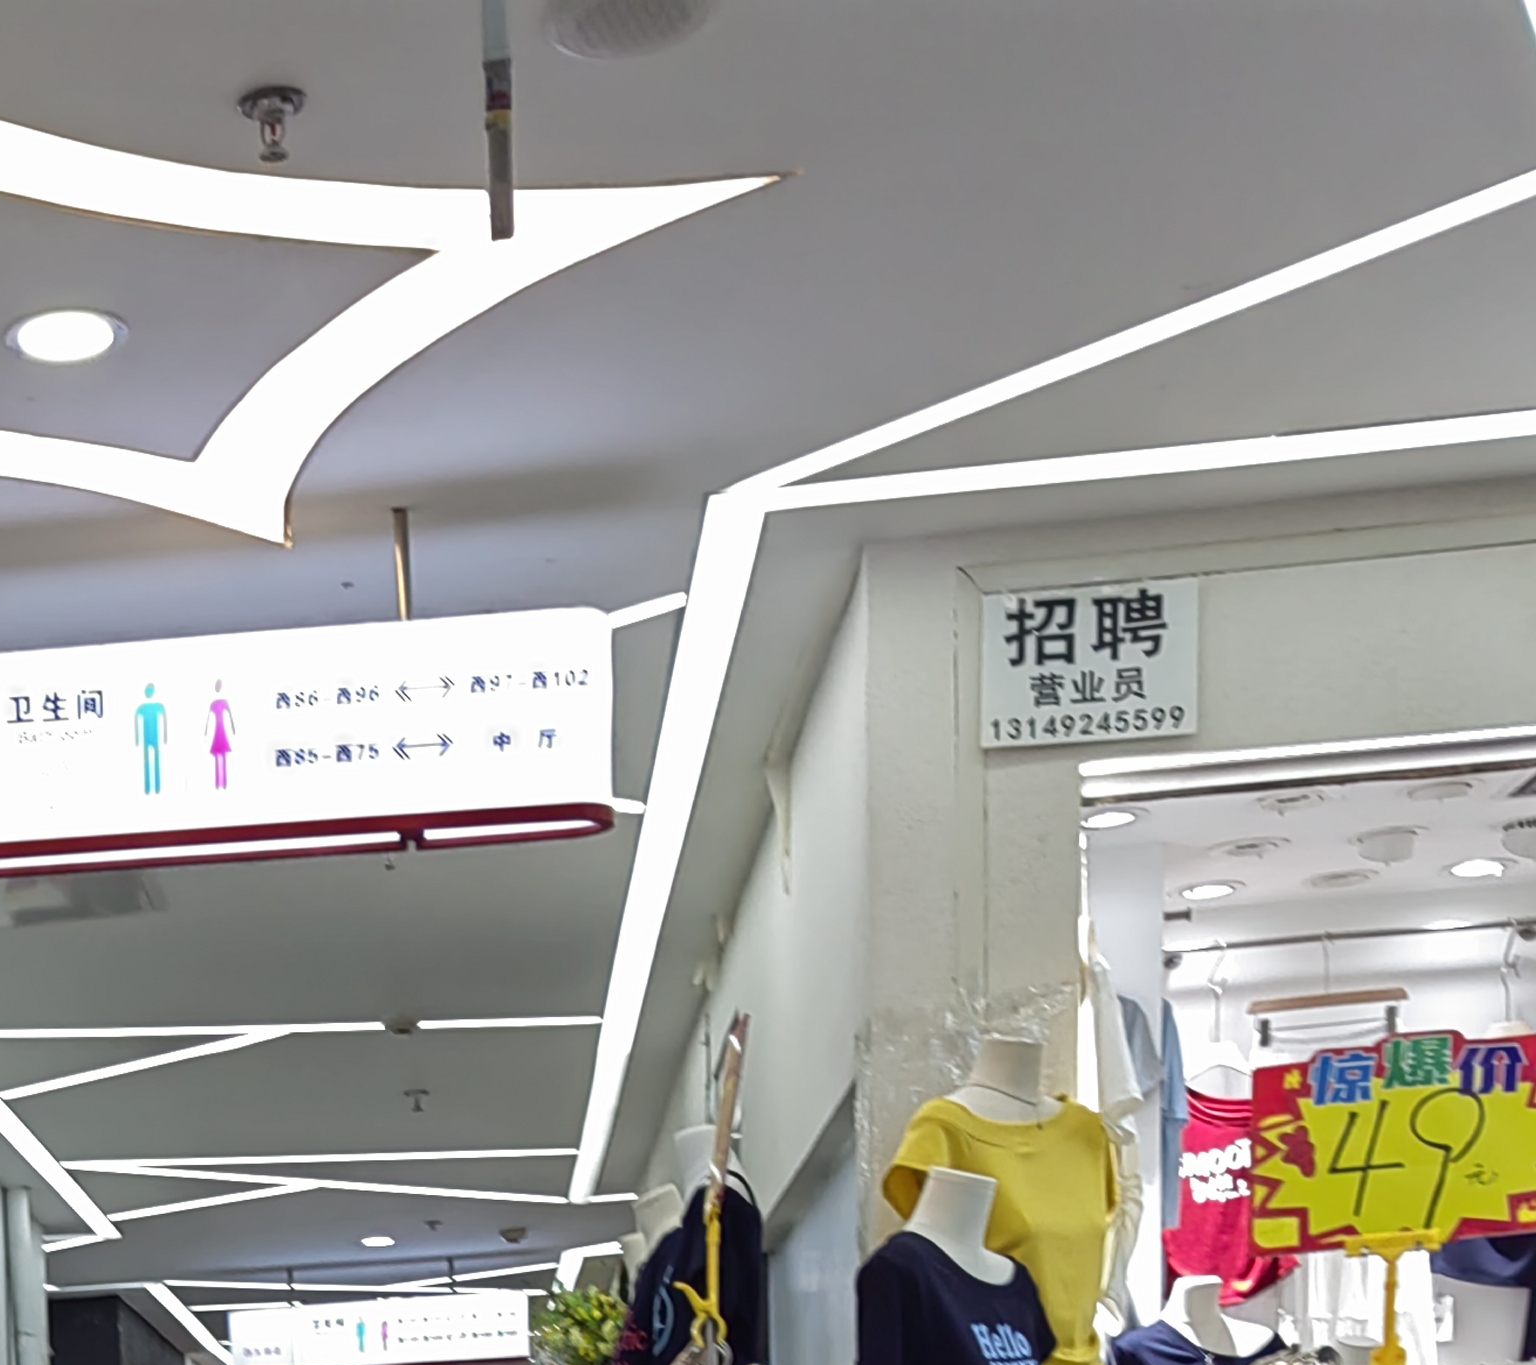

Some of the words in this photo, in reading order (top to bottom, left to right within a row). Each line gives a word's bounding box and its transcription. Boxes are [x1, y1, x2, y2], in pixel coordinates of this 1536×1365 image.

[1003, 588, 1168, 667] 招聘
[6, 690, 104, 723] 卫生间
[1029, 666, 1148, 708] 营业员
[990, 705, 1186, 742] 13149245599
[1308, 1034, 1528, 1106] 惊爆价
[1327, 1087, 1486, 1230] 49
[969, 1322, 1032, 1361] Hello
